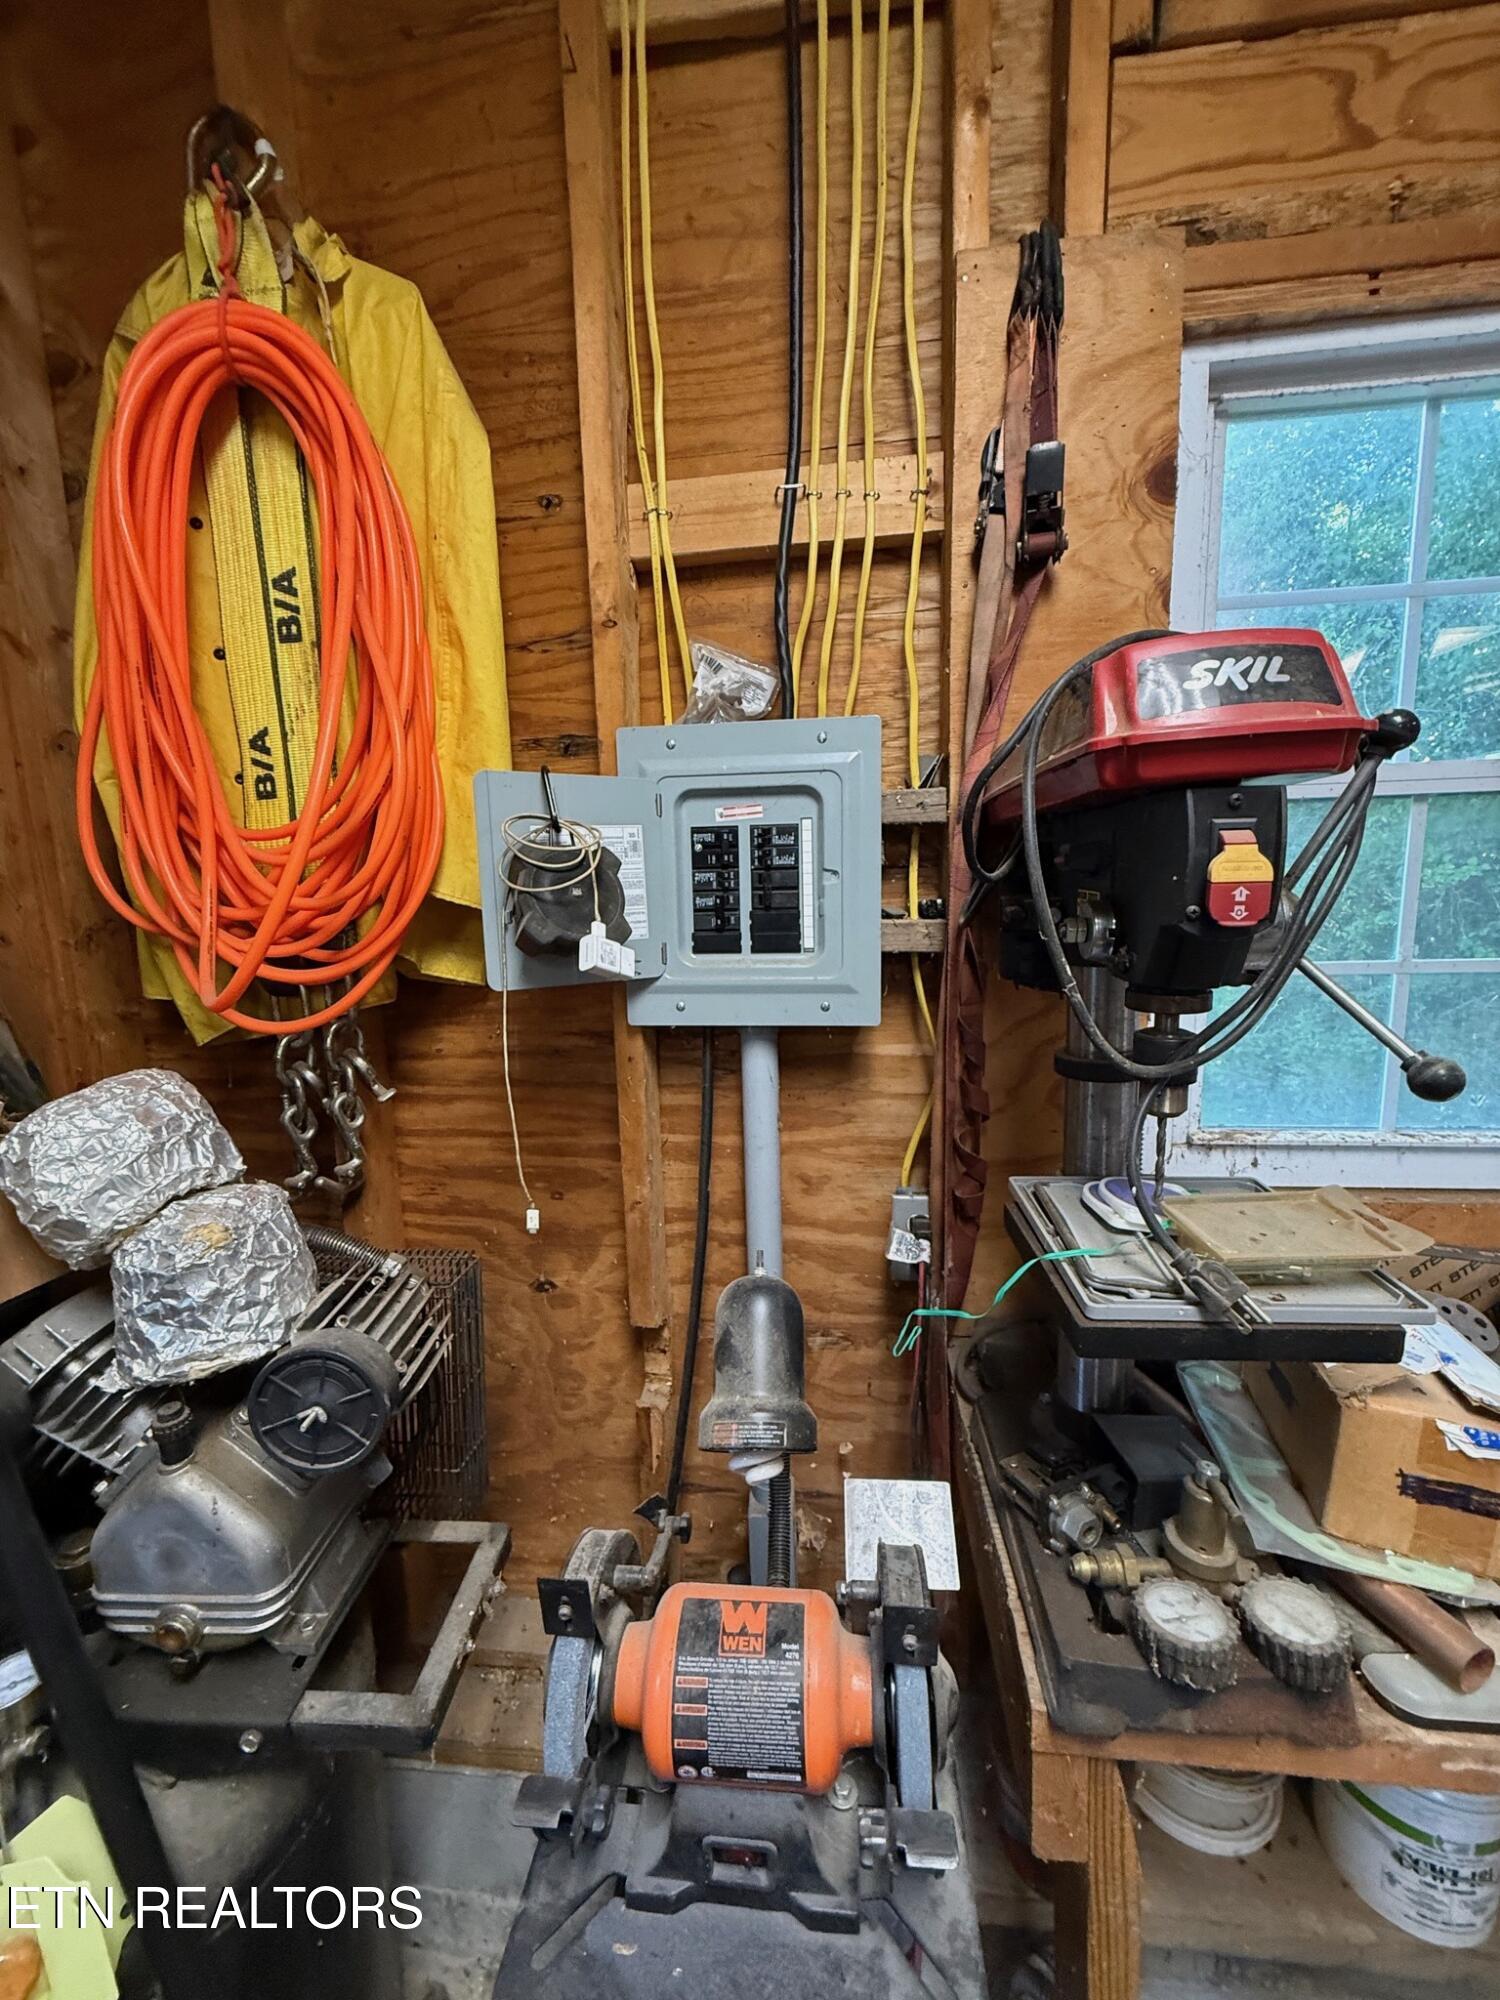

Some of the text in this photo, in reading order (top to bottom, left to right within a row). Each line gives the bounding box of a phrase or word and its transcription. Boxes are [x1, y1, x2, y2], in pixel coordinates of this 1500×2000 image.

[271, 566, 303, 644] B/A
[1182, 655, 1290, 692] SKIL
[248, 726, 278, 800] B/A
[722, 1636, 762, 1651] WEN
[781, 1642, 800, 1650] Model
